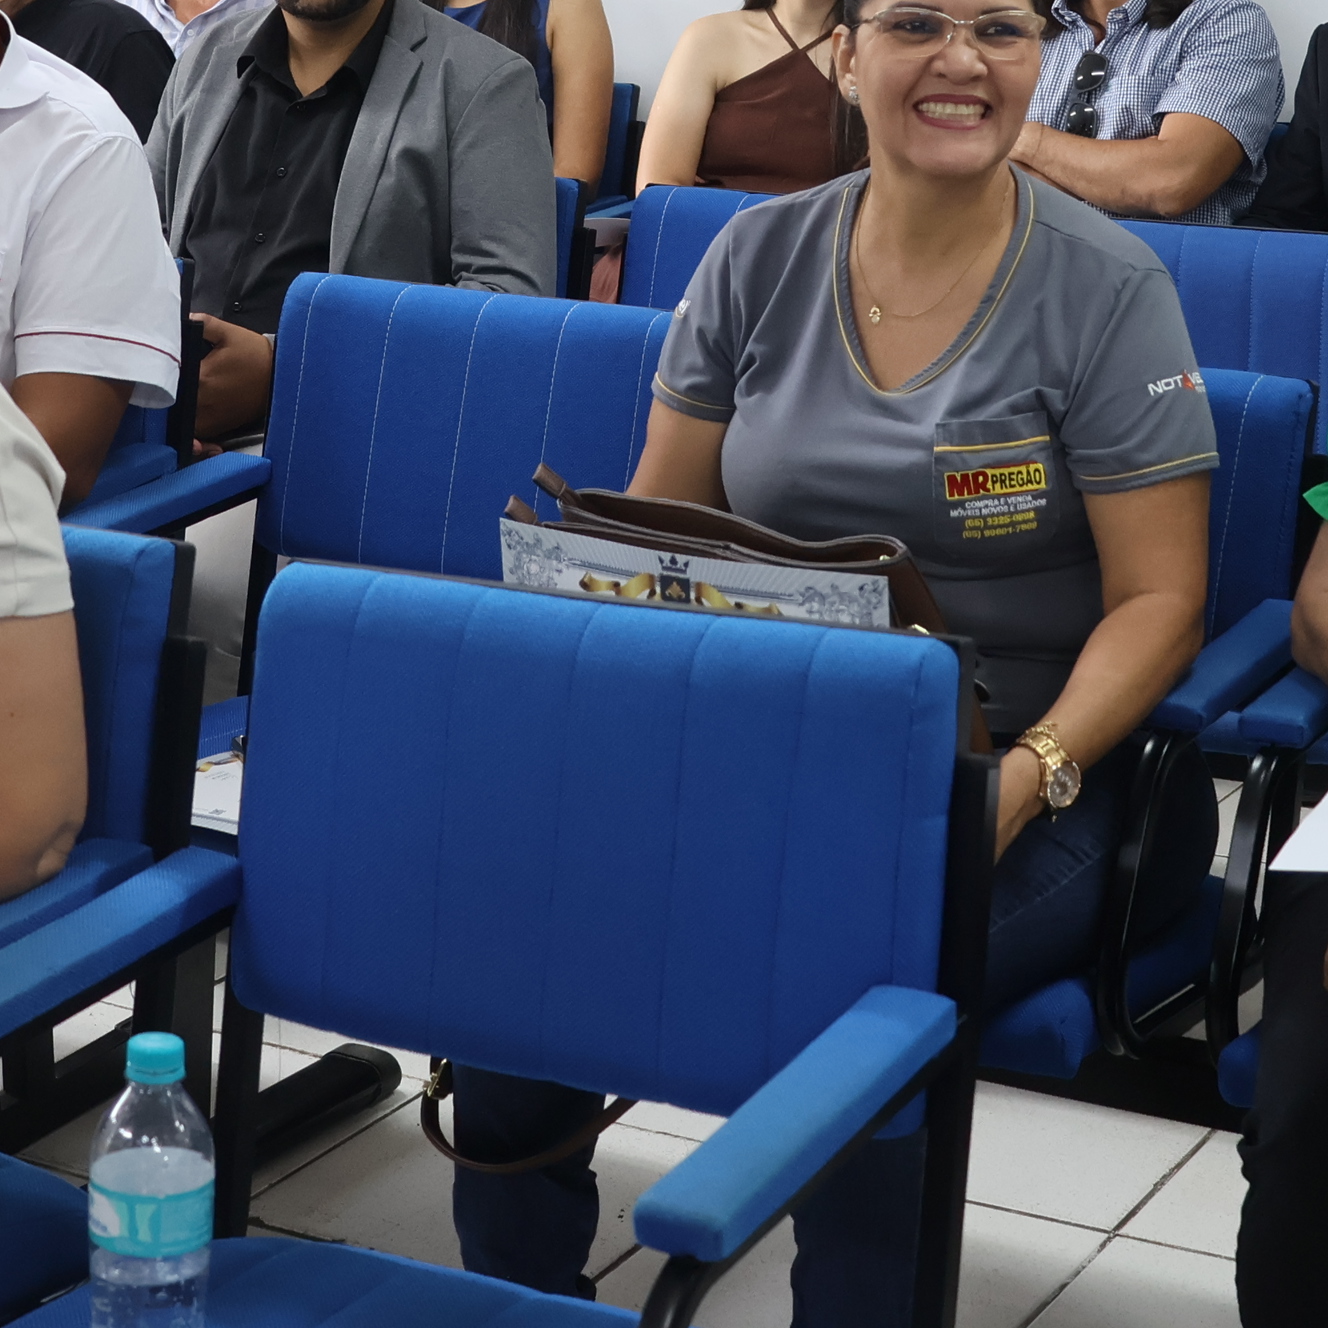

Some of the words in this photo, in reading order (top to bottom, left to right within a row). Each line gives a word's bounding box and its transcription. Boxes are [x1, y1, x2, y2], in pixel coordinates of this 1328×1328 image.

[946, 470, 991, 498] MR
[991, 465, 1042, 492] PREGÃO
[950, 507, 980, 517] MÓVEIS
[982, 505, 1009, 517] NOVOS
[1016, 498, 1047, 510] USADOS
[965, 498, 1000, 509] COMPRA
[1007, 494, 1033, 504] VENDA
